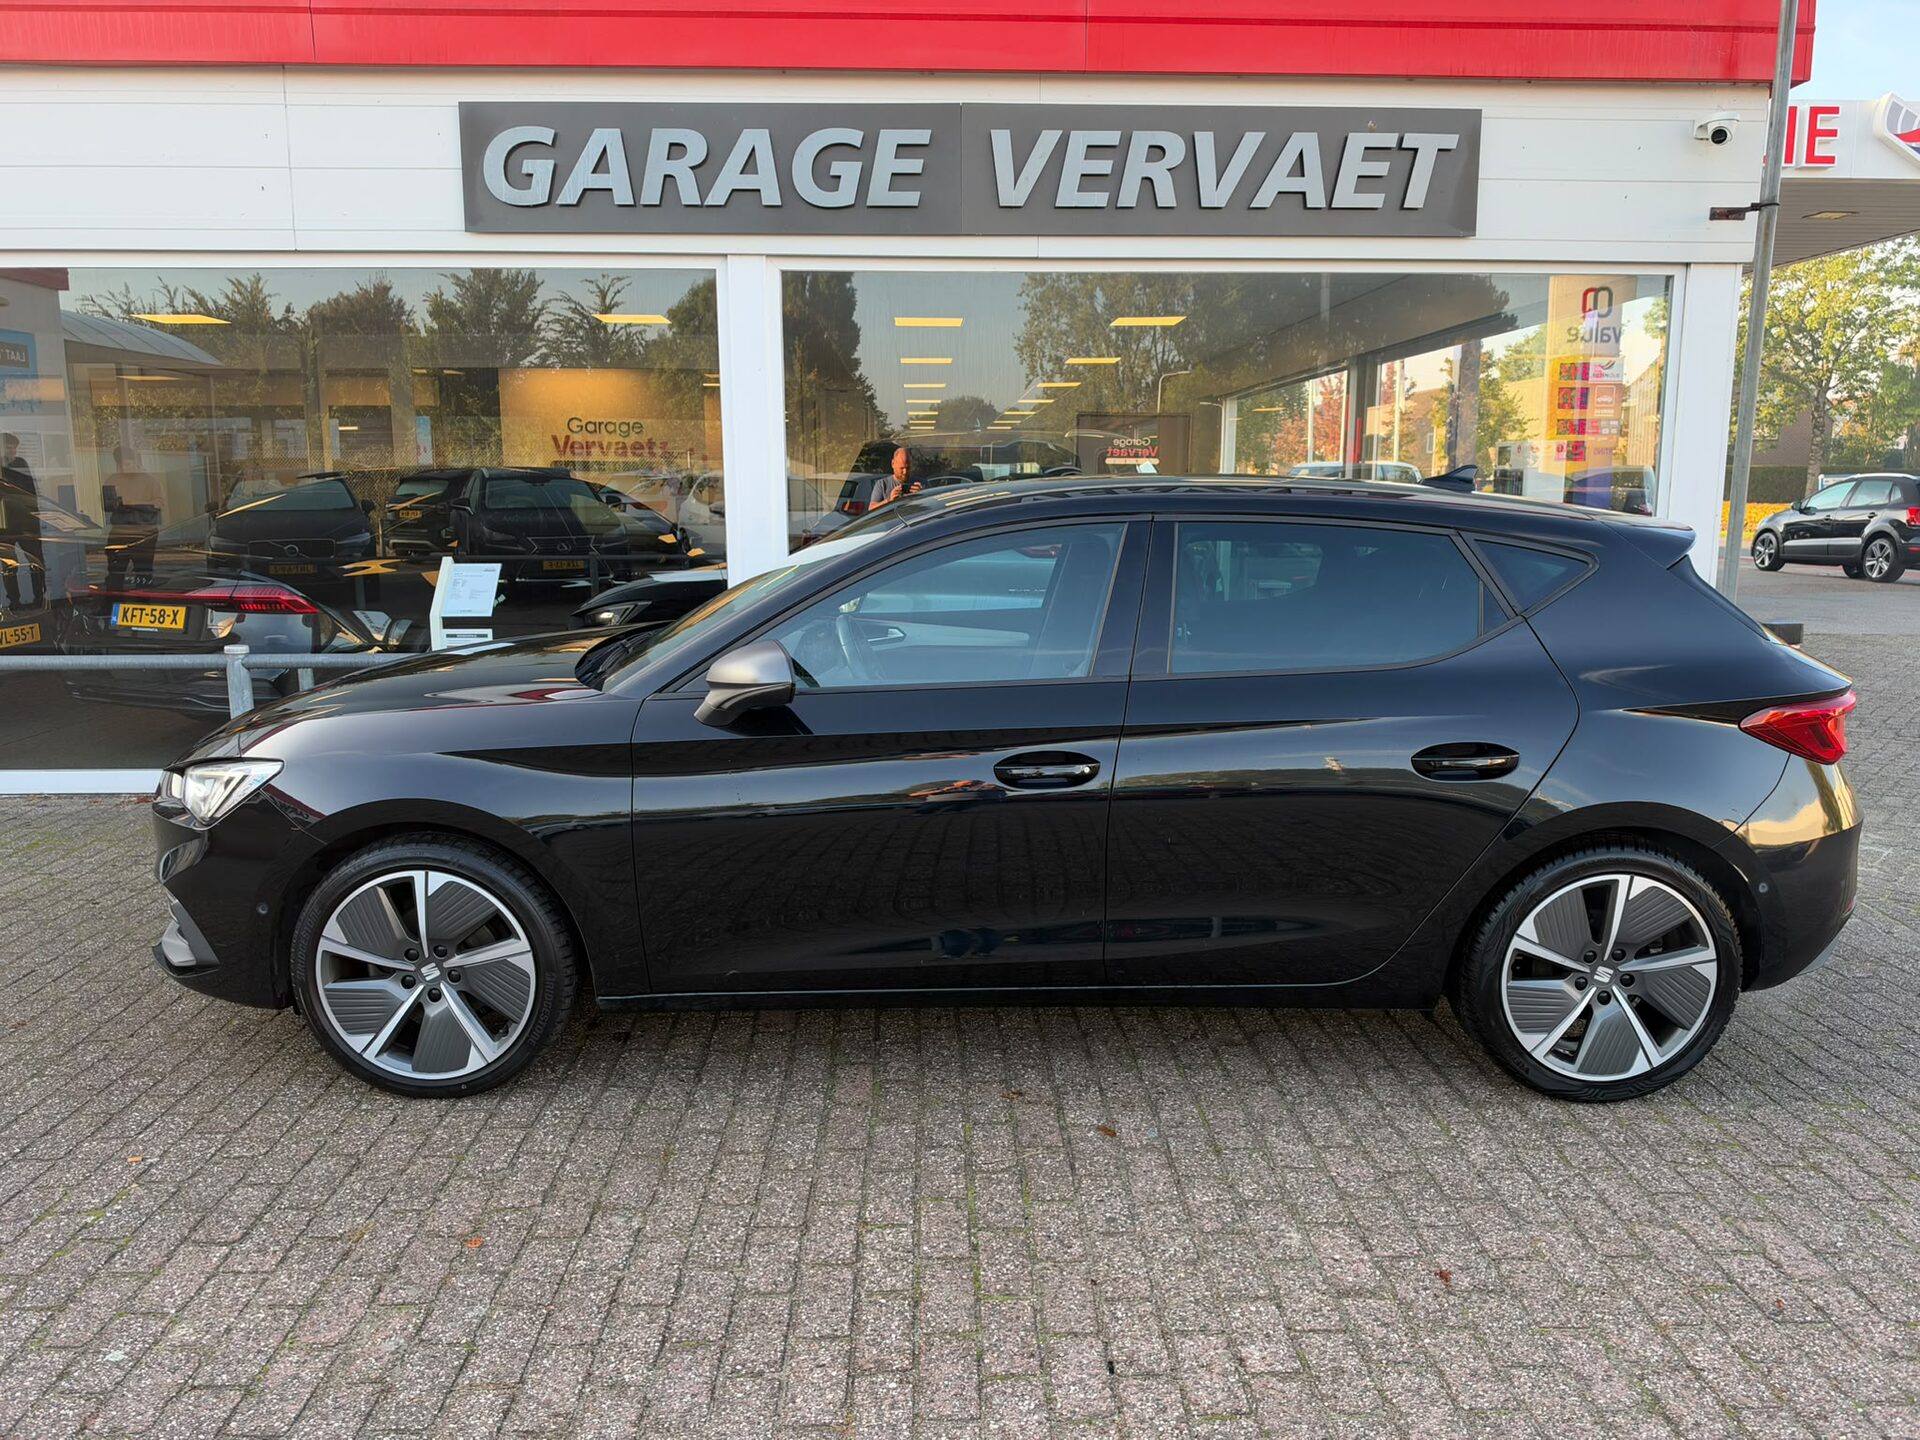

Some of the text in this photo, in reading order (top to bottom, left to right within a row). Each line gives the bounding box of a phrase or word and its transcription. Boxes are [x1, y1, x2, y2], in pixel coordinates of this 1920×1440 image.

[1763, 105, 1840, 165] IE
[483, 125, 1461, 209] GARAGE VERVAET
[566, 416, 645, 438] Garage
[551, 435, 656, 457] Vervaet
[121, 606, 180, 625] KFT-58-X
